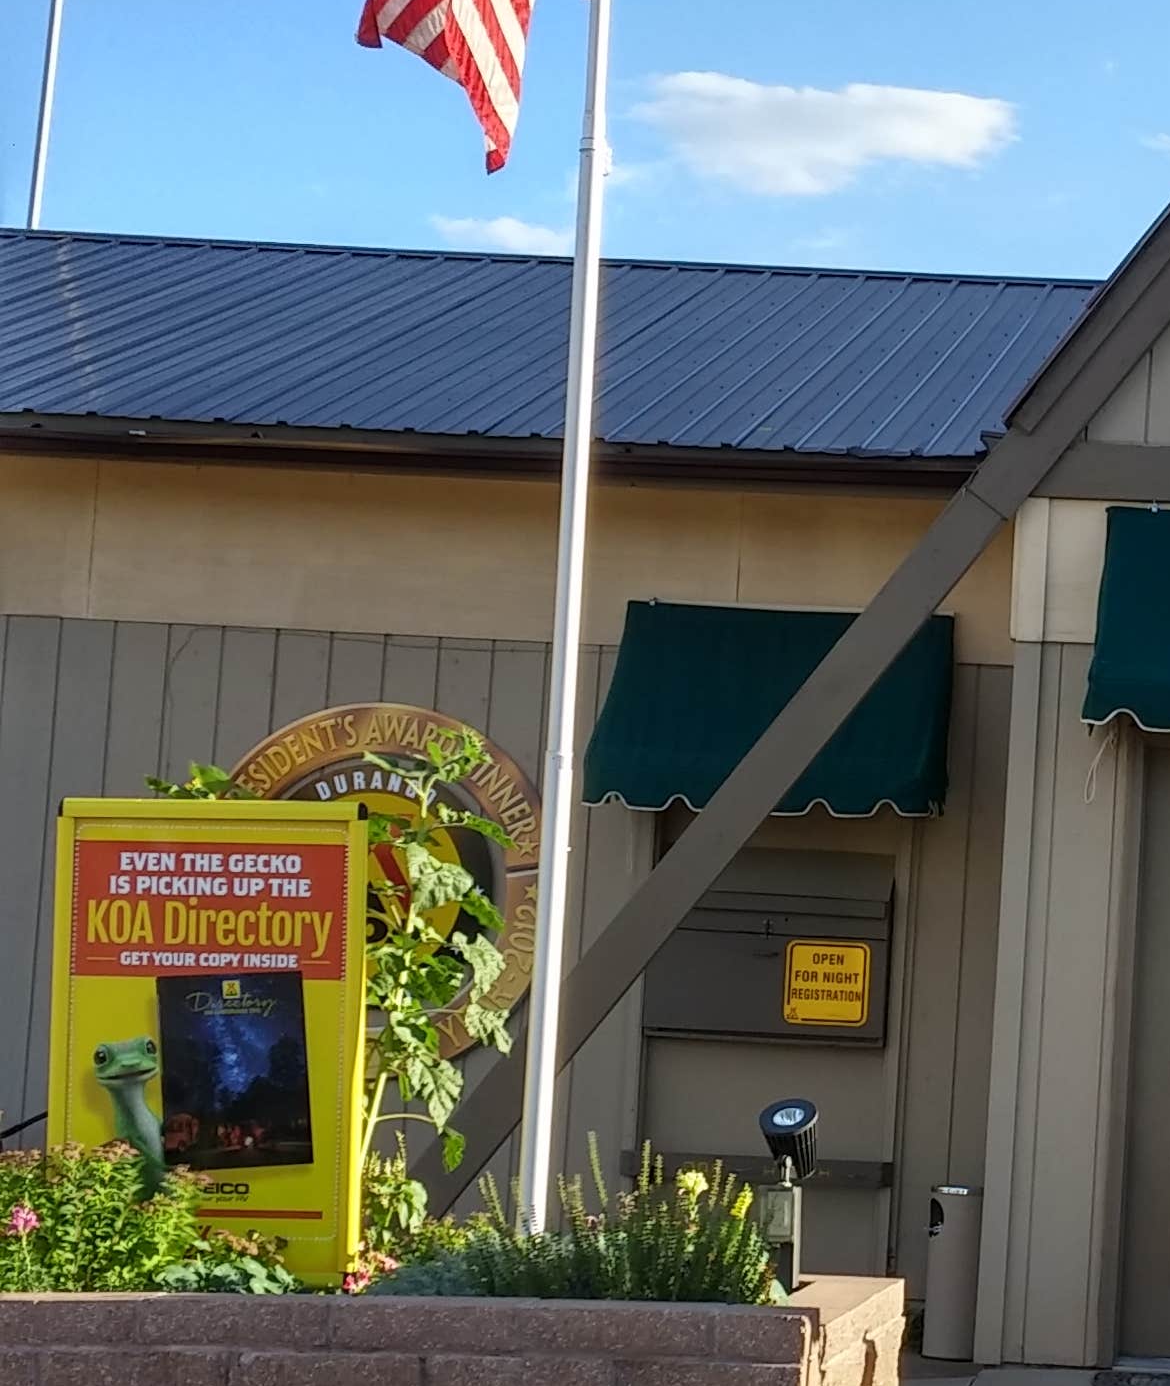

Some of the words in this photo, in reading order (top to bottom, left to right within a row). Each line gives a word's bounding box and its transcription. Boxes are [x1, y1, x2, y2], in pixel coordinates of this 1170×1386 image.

[225, 714, 357, 798] ESIDENT'S
[467, 762, 538, 844] INNER
[119, 852, 176, 872] EVEN
[181, 853, 224, 873] THE
[228, 854, 302, 874] GECKO
[110, 875, 131, 895] IS
[135, 876, 227, 896] PICKING
[232, 877, 265, 897] UP
[268, 878, 312, 898] THE
[86, 899, 154, 944] KOA
[164, 896, 333, 959] Directory
[120, 951, 150, 966] GET
[151, 952, 196, 967] YOUR
[199, 953, 240, 968] COPY
[243, 953, 299, 969] INSIDE
[812, 953, 845, 966] OPEN
[794, 970, 818, 983] FOR
[822, 971, 860, 985] NIGHT
[791, 988, 861, 1003] REGISTRATION
[203, 1183, 249, 1195] EICO
